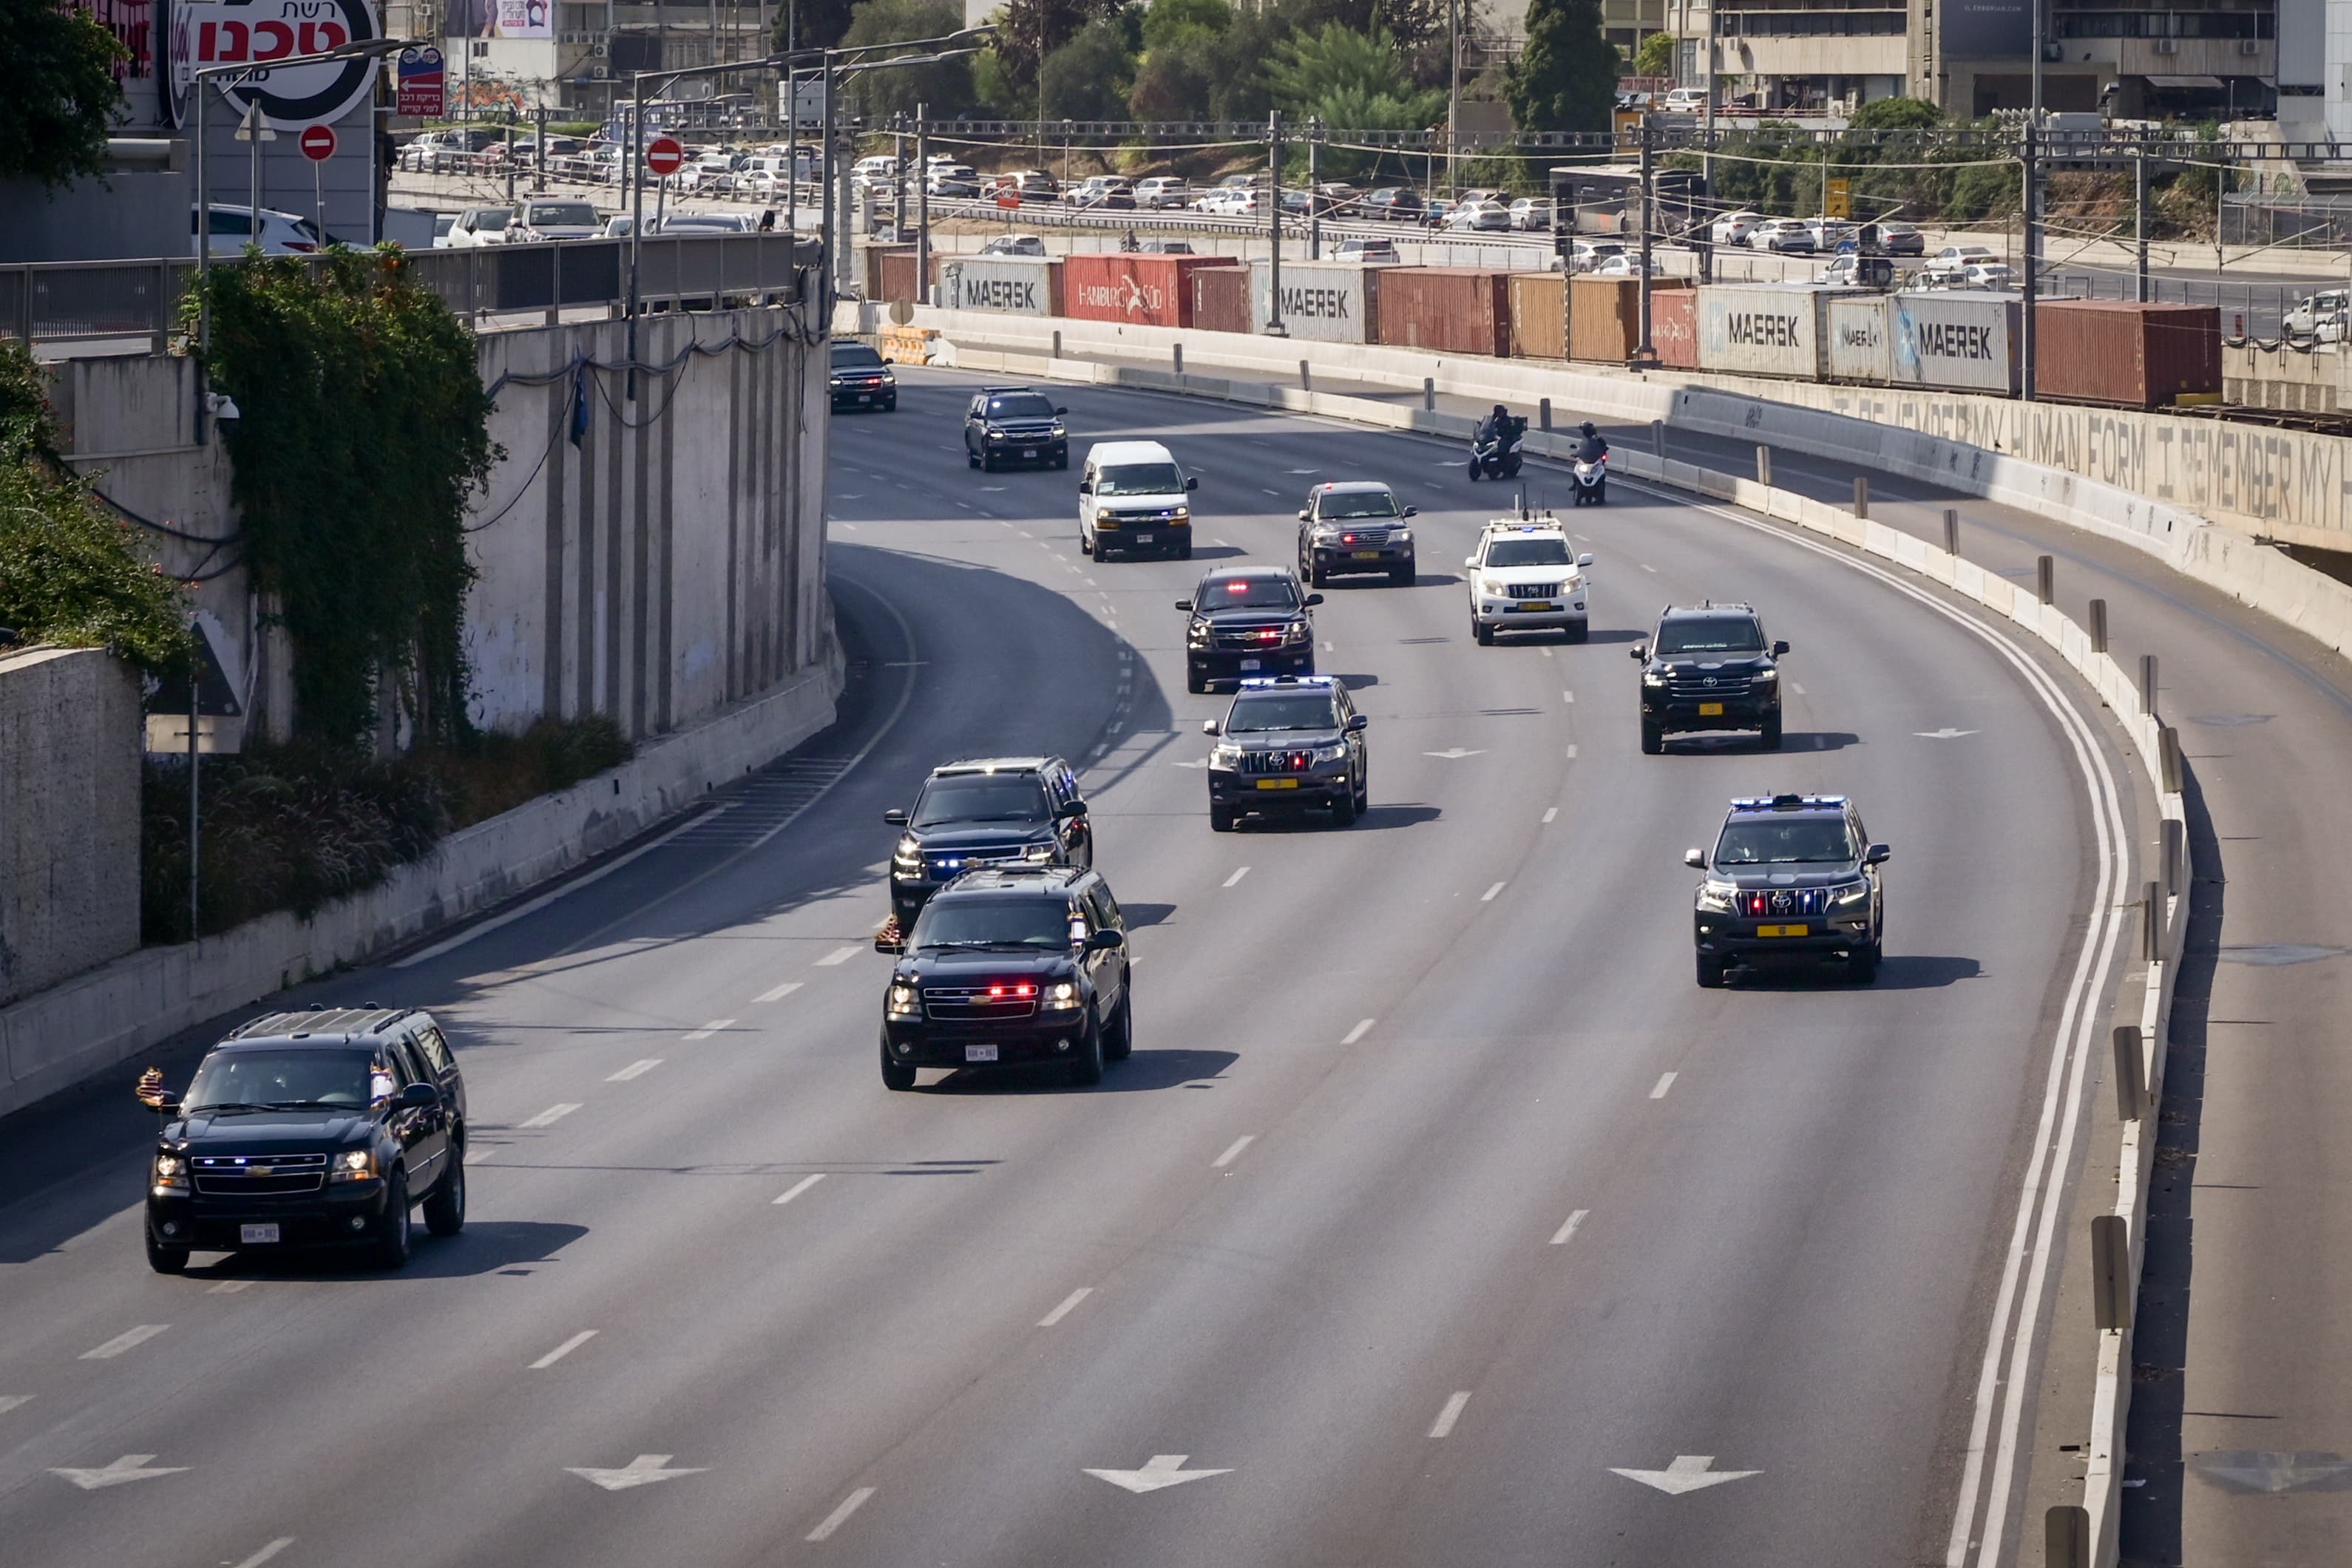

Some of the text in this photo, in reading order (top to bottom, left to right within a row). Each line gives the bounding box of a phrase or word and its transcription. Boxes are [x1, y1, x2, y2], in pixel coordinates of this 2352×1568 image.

[280, 1, 335, 18] רשת
[197, 20, 346, 62] טכנו
[401, 104, 438, 113] לפני קנייה
[967, 279, 1035, 308] MAERSK
[1079, 282, 1162, 310] HAMBURG SÜD
[1280, 287, 1349, 319] MAERSK
[1729, 313, 1799, 347] MAERSK
[1919, 322, 1992, 360] MAERSK
[2011, 401, 2080, 473] HUMAN
[2088, 413, 2144, 494] FORM
[2157, 426, 2175, 499] I
[2181, 427, 2291, 521] REMEMBER
[2300, 440, 2333, 527] MY
